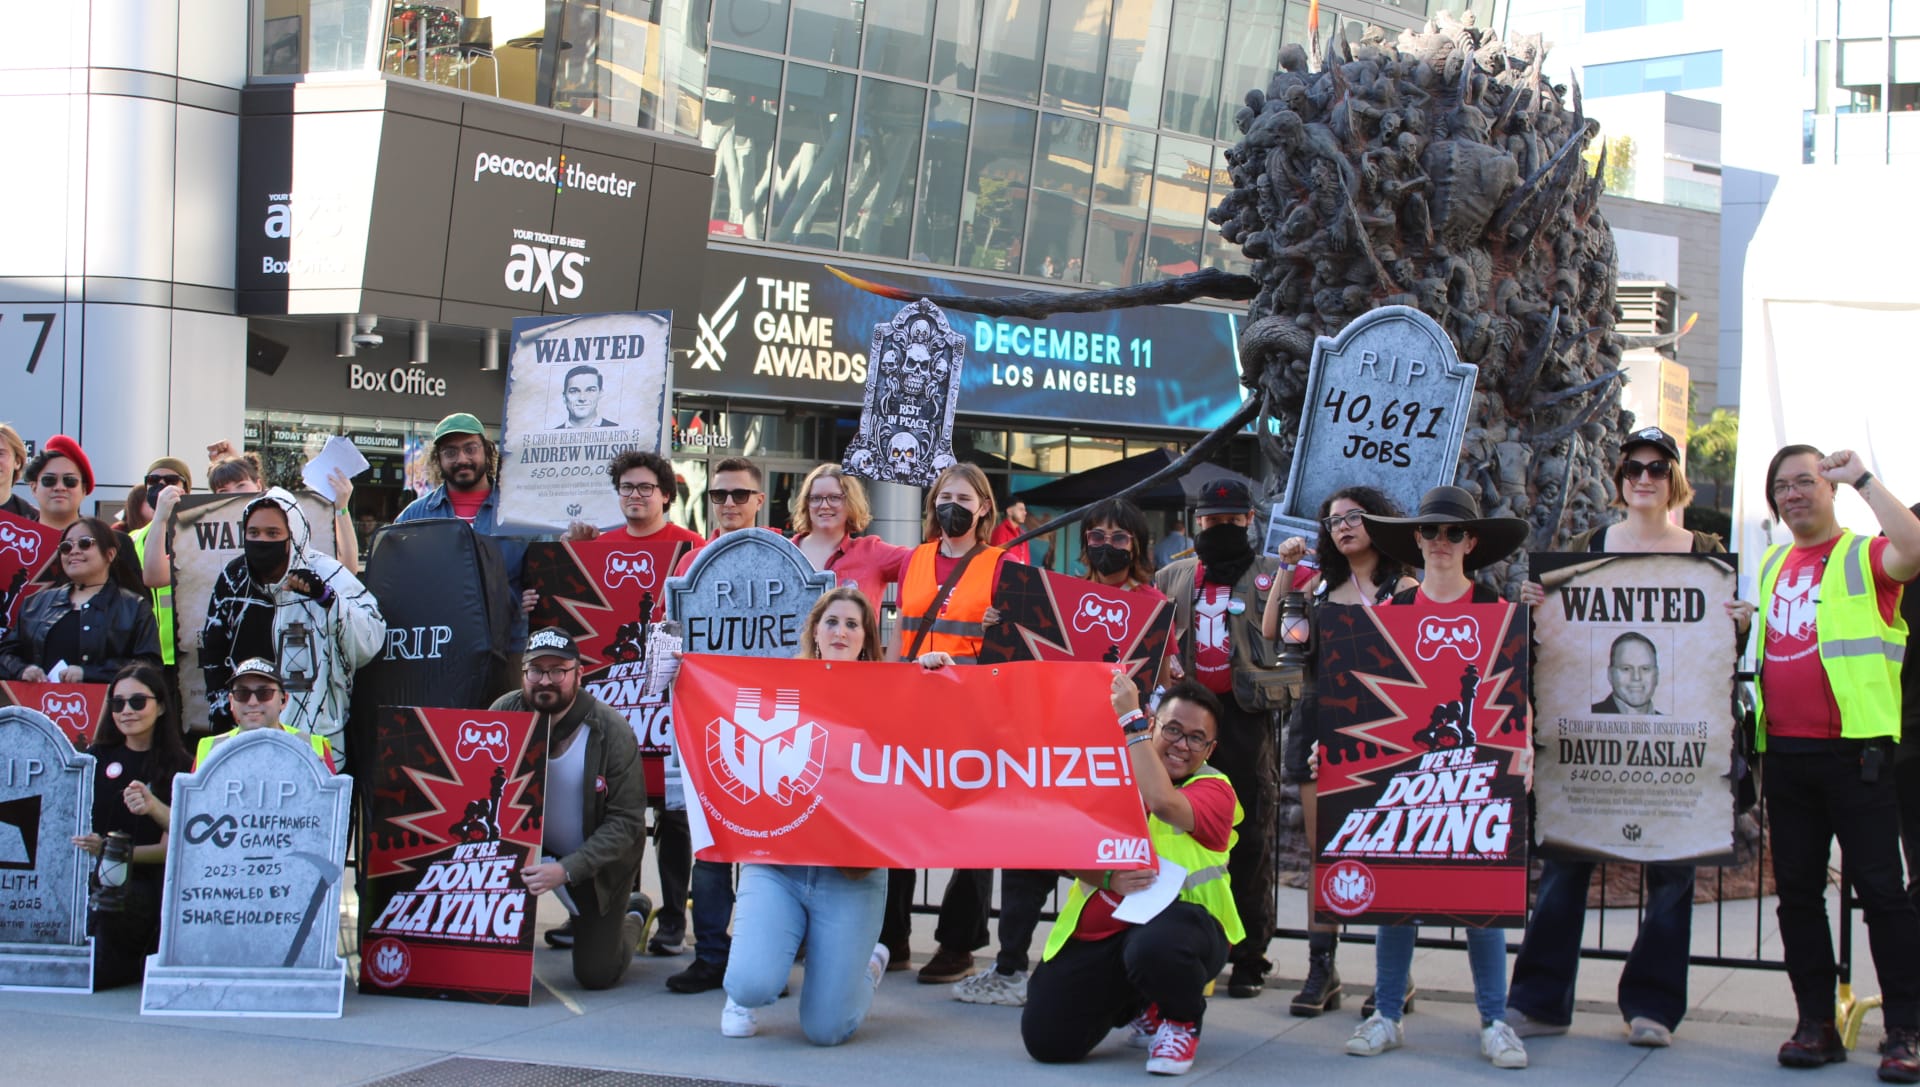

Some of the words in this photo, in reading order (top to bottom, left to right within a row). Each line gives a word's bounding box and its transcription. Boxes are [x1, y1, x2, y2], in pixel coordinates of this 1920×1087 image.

[474, 152, 558, 184] peacock
[566, 163, 636, 198] theater
[513, 228, 533, 240] YOUR
[534, 232, 559, 245] TICKET
[559, 236, 567, 246] IS
[567, 237, 586, 248] HERE
[505, 243, 585, 305] axs
[757, 277, 810, 313] THE
[754, 311, 833, 348] GAME
[975, 321, 1122, 366] DECEMBER
[1130, 338, 1152, 368] 11
[535, 334, 645, 364] WANTED
[753, 345, 867, 384] AWARDS
[1358, 350, 1427, 385] RIP
[350, 364, 387, 392] Box
[390, 368, 447, 396] Office
[992, 363, 1034, 388] LOS
[1043, 368, 1137, 397] ANGELES
[888, 415, 898, 425] IN
[900, 417, 930, 430] PEACE
[899, 404, 922, 416] REST
[1324, 387, 1445, 439] 40,691
[354, 435, 399, 447] RESOLUTION
[680, 424, 733, 448] theater
[520, 445, 581, 464] ANDREW
[1343, 435, 1411, 468] JOBS
[714, 578, 784, 608] RIP
[1559, 587, 1706, 624] WANTED
[383, 625, 452, 660] RIP
[688, 614, 798, 651] FUTURE
[608, 661, 648, 679] WE'R
[1595, 721, 1630, 734] WARNER
[1653, 722, 1697, 736] DISCOVERY
[851, 743, 1132, 789] UNIONIZE!
[1418, 746, 1477, 771] WE'RE
[1558, 738, 1622, 765] DAVID
[1627, 740, 1707, 768] ZASLAV
[8, 758, 45, 787] IP
[1375, 766, 1498, 807] DONE
[1570, 770, 1696, 785] $400,000,000
[224, 780, 298, 809] RIP
[241, 814, 321, 829] CLIFFHANGER
[699, 791, 722, 821] UNITED
[722, 817, 769, 838] VIDEOGAME
[1323, 803, 1512, 852] PLAYING
[240, 833, 292, 849] GAMES
[452, 841, 501, 860] WE'RE
[1097, 839, 1150, 861] CWA
[2, 875, 38, 890] LITH
[204, 863, 282, 878] 2023-2025
[415, 859, 517, 891] DONE
[182, 886, 264, 901] STRANGLED
[269, 884, 292, 899] BY
[182, 909, 302, 926] SHAREHOLDERS
[371, 893, 526, 938] PLAYING
